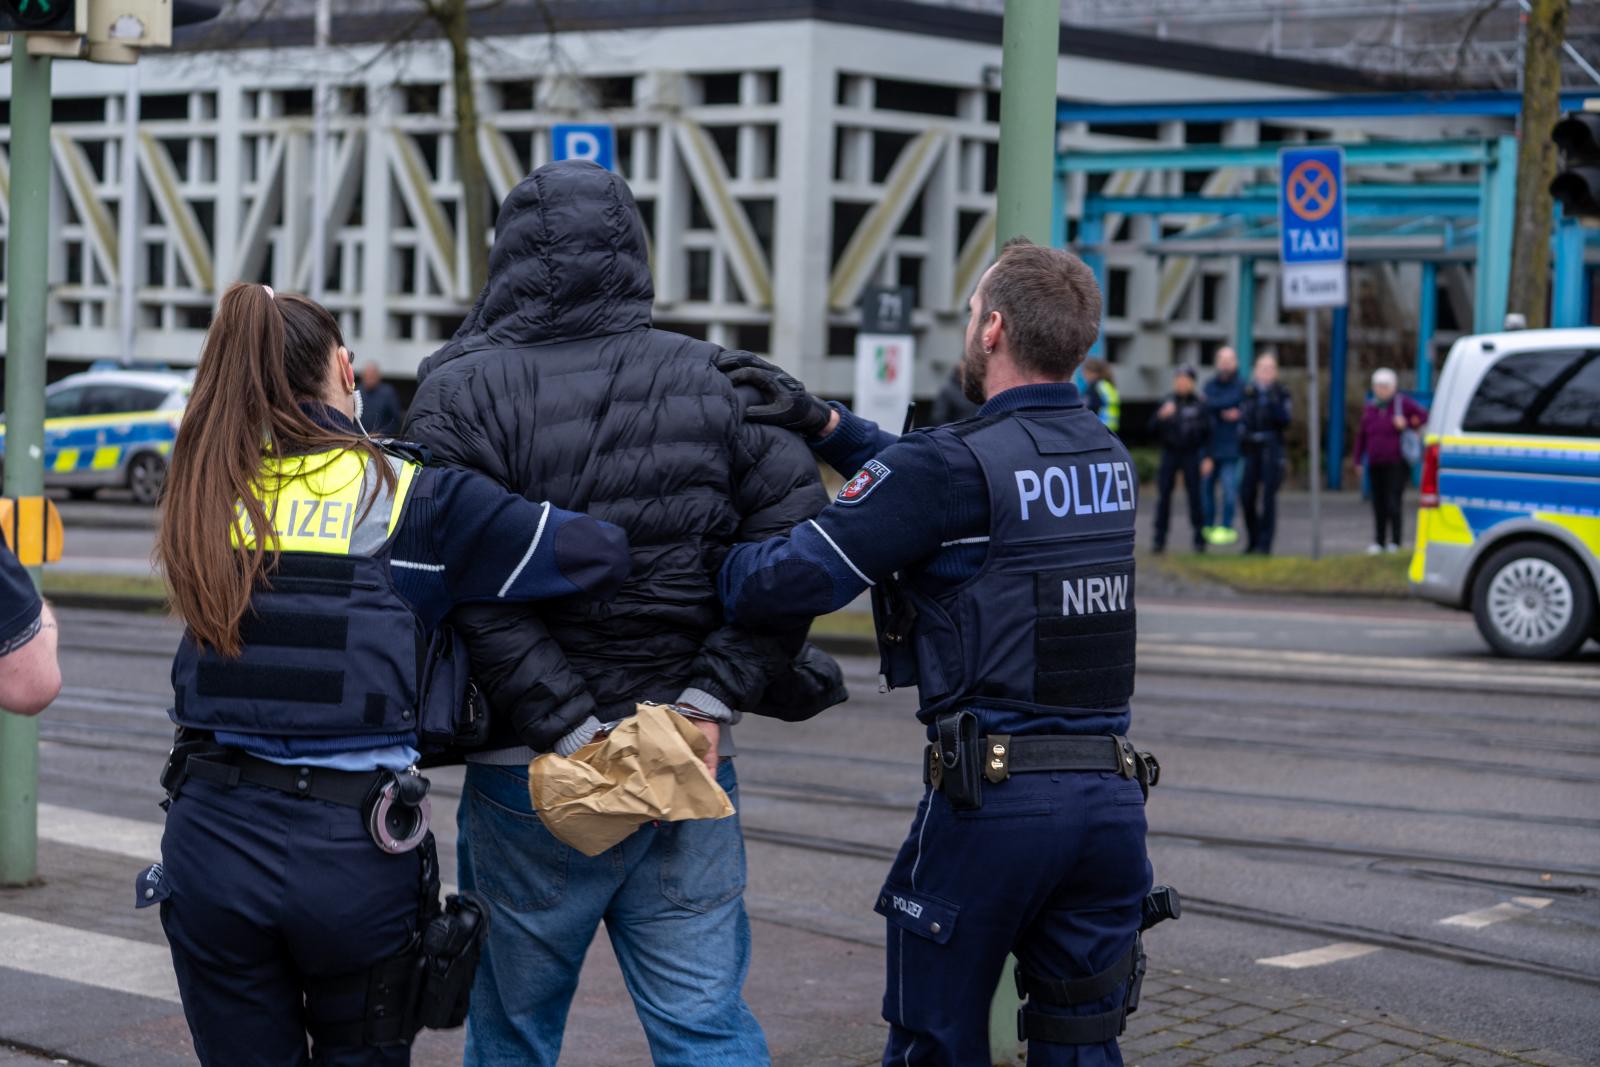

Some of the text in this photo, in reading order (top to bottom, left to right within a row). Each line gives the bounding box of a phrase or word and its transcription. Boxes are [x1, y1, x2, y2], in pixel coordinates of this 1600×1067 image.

[1287, 228, 1339, 254] TAXI
[1014, 462, 1135, 520] POLIZEI
[1062, 574, 1128, 616] NRW
[893, 895, 923, 919] POLIZEI
